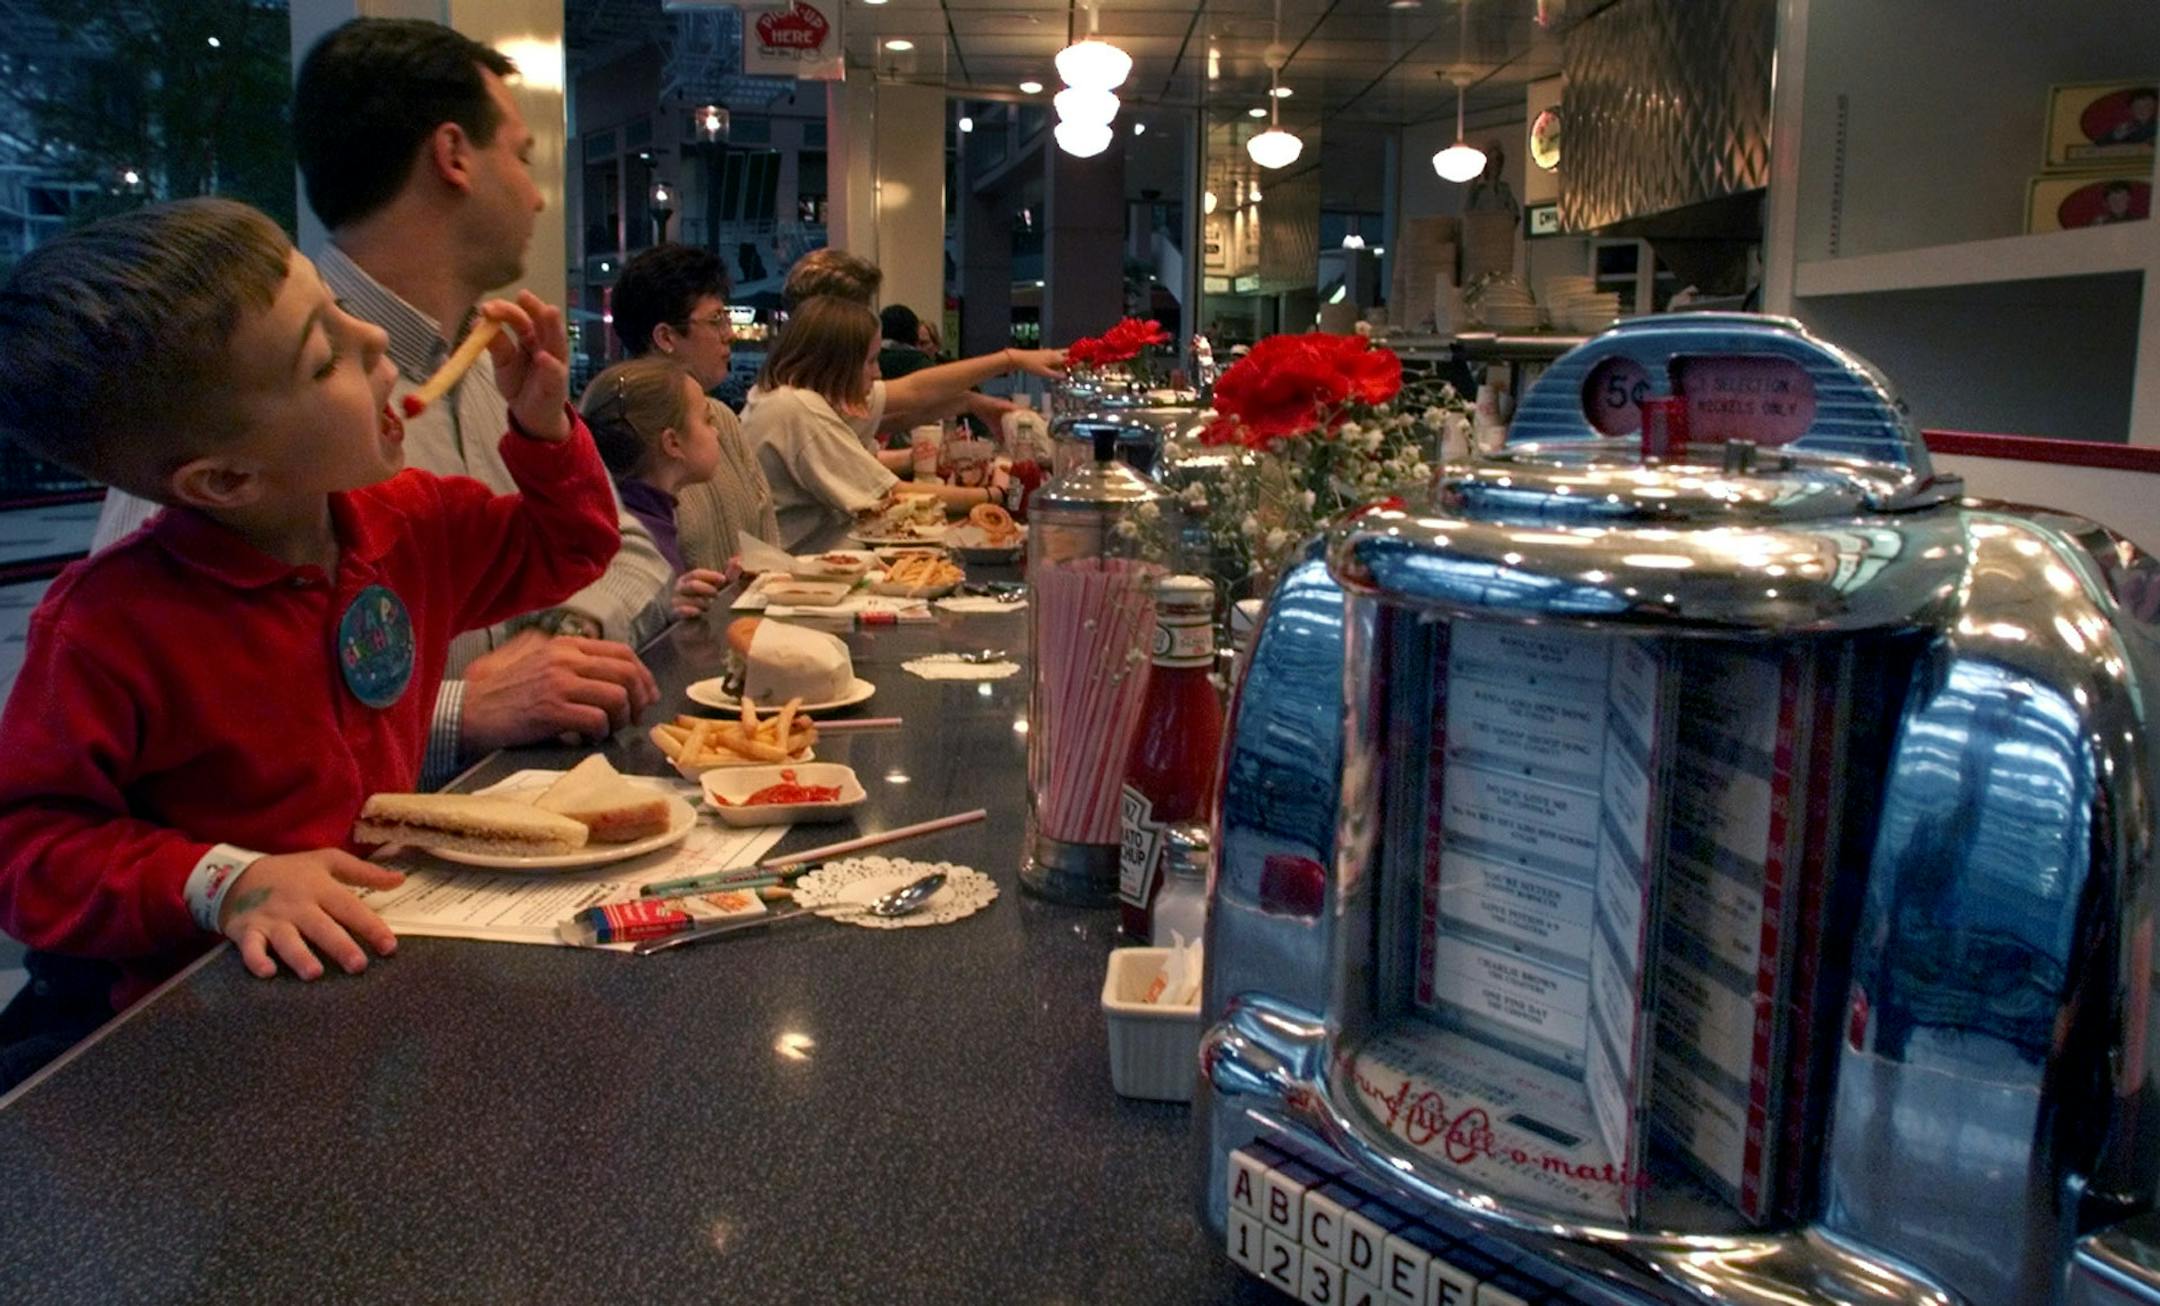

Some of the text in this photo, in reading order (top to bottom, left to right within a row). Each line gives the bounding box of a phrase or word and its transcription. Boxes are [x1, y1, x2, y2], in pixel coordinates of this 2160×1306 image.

[772, 29, 813, 43] HERE
[1761, 399, 1798, 417] ONLY
[1121, 828, 1143, 848] ATO
[1120, 843, 1145, 866] CHUP
[1528, 1003, 1548, 1020] DAY
[1234, 1168, 1252, 1207] A
[1270, 1186, 1289, 1225] B
[1311, 1211, 1331, 1249] C
[1350, 1229, 1373, 1270] D
[1391, 1254, 1416, 1299] E
[1238, 1224, 1330, 1304] 1 2 3
